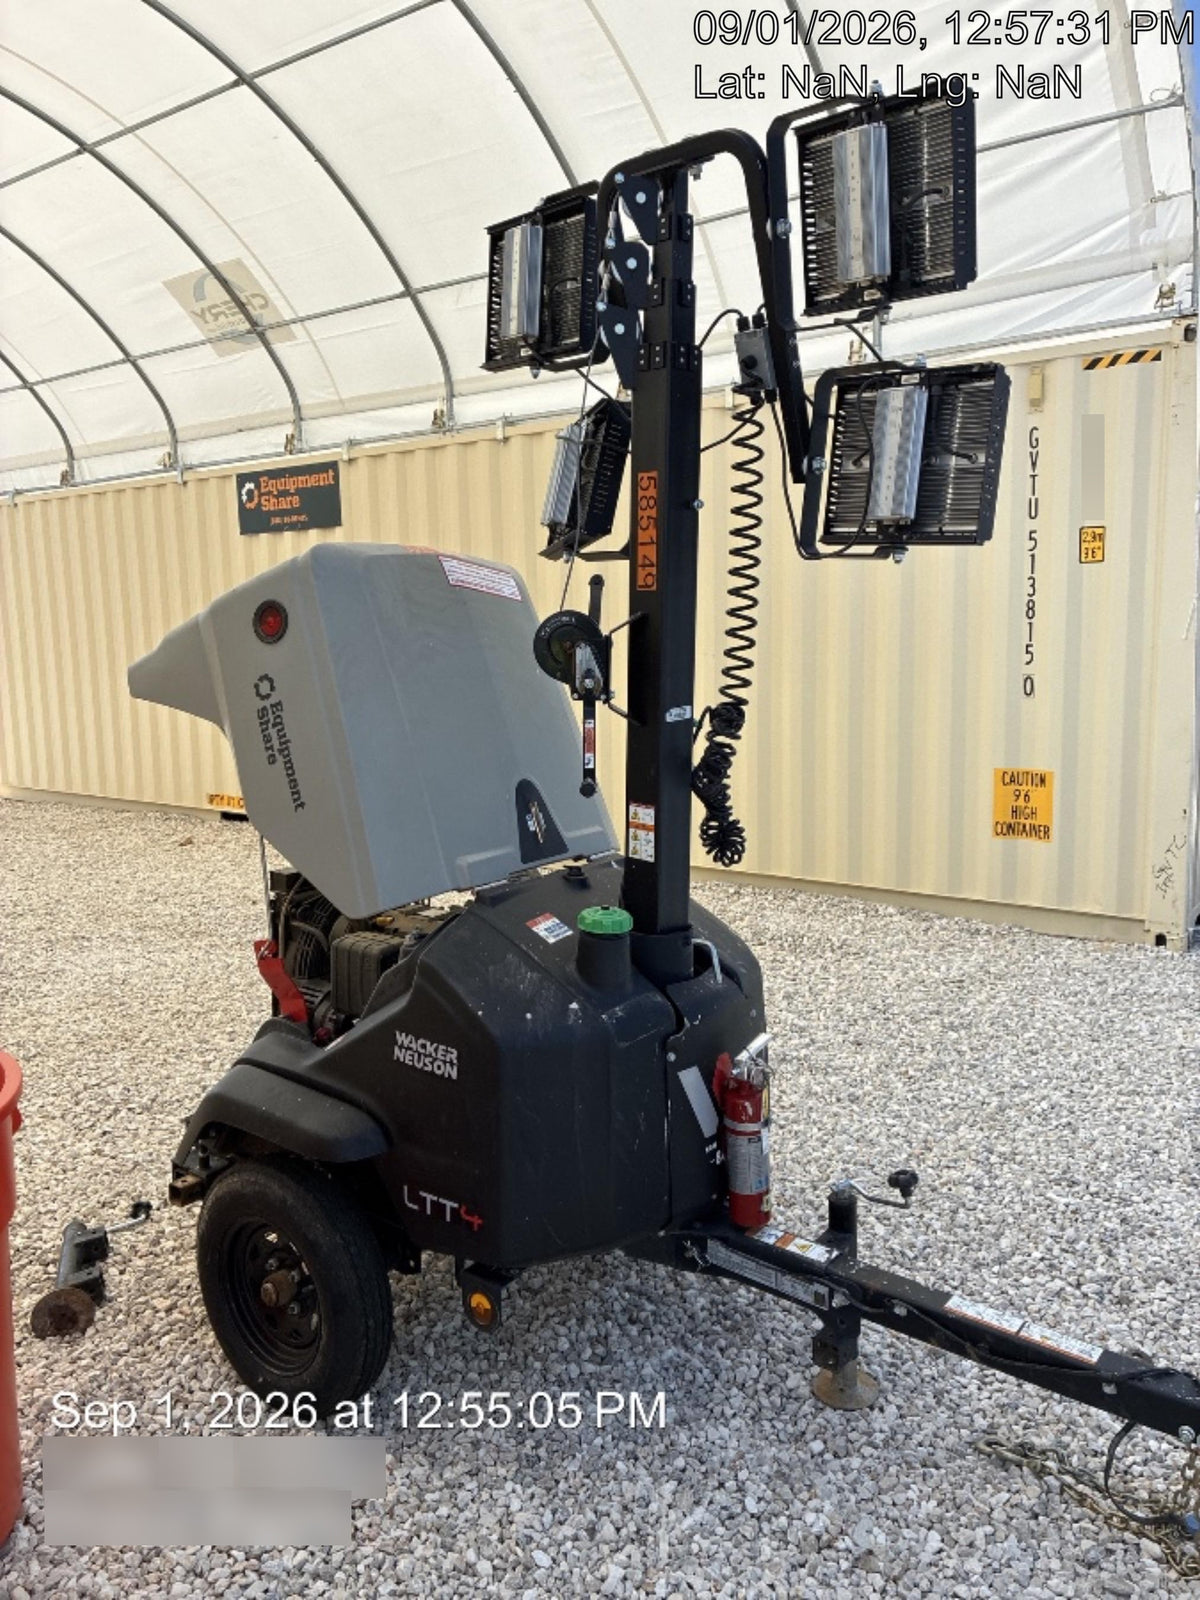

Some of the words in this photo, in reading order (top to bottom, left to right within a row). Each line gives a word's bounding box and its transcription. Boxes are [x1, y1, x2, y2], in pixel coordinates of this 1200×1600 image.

[260, 469, 335, 495] Equipment
[1028, 426, 1039, 520] GVTU
[261, 495, 300, 511] Share
[638, 475, 656, 589] 585149
[1024, 529, 1038, 666] 513815
[257, 705, 277, 766] Share
[269, 700, 306, 813] Equipment
[1002, 771, 1046, 788] CAUTION
[1011, 805, 1037, 820] HIGH
[995, 821, 1050, 840] CONTAINER
[393, 1045, 458, 1080] NEUSON
[395, 1030, 458, 1064] WACKER
[403, 1184, 484, 1232] LTT4
